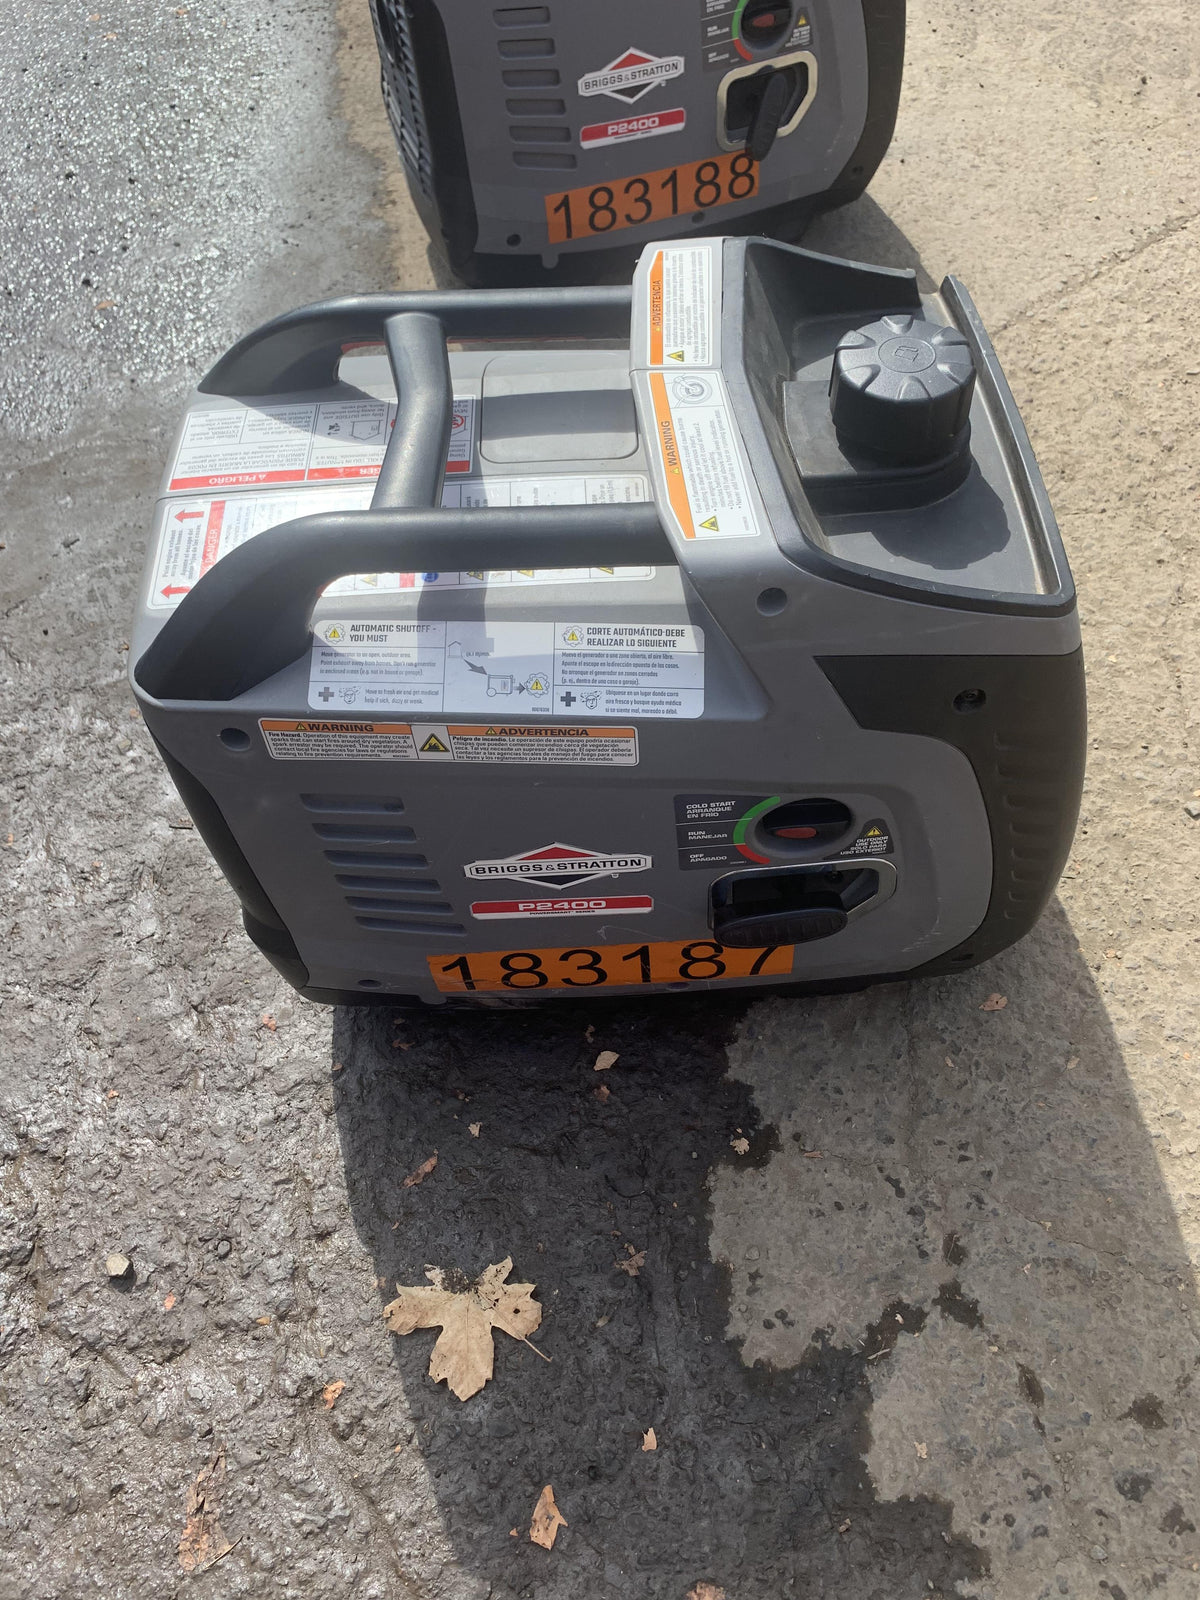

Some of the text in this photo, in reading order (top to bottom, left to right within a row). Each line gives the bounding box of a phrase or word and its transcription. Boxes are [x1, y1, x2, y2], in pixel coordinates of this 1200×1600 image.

[583, 60, 680, 92] BRIGGS&STRATTON
[607, 116, 660, 136] P2400
[553, 152, 756, 239] 183188
[653, 280, 661, 326] ADVERTENCIA
[660, 421, 678, 466] WARNING
[209, 474, 256, 485] PELIGRO
[204, 528, 219, 562] DANGER
[351, 624, 394, 632] AUTOMATIC
[587, 626, 685, 637] CORTE AUTOMÁTICO-DEBE
[587, 638, 624, 646] REALIZAR
[638, 639, 676, 647] SIGUIENTE
[308, 724, 373, 732] WARNING
[499, 728, 588, 736] ADVERTENCIA
[687, 806, 732, 814] ARRANQUE
[689, 833, 727, 841] MANEJAR
[475, 859, 641, 874] BRIGGS&STRATTON
[518, 900, 606, 911] P2400
[442, 941, 782, 991] 183187
